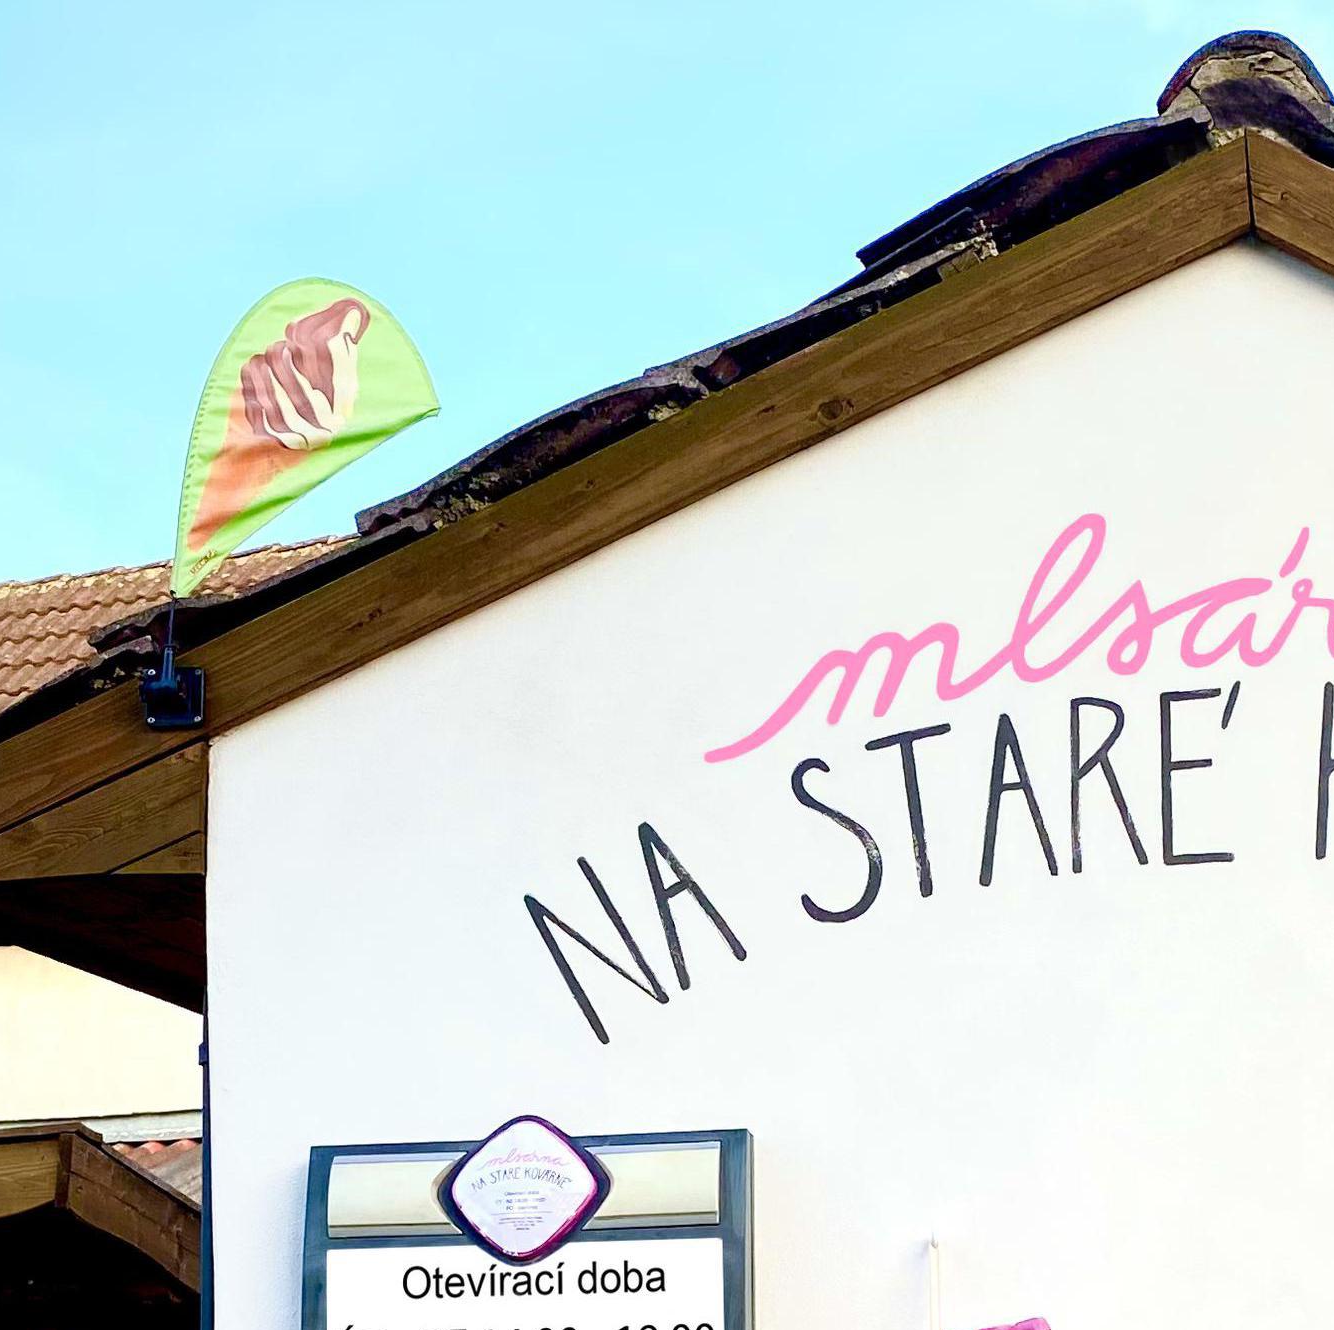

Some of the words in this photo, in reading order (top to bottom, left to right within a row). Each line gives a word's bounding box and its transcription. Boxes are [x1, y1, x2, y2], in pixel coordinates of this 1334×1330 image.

[523, 821, 748, 1045] NA
[790, 680, 1242, 924] STARÉ
[402, 1261, 565, 1300] Otevírací
[577, 1259, 666, 1295] doba
